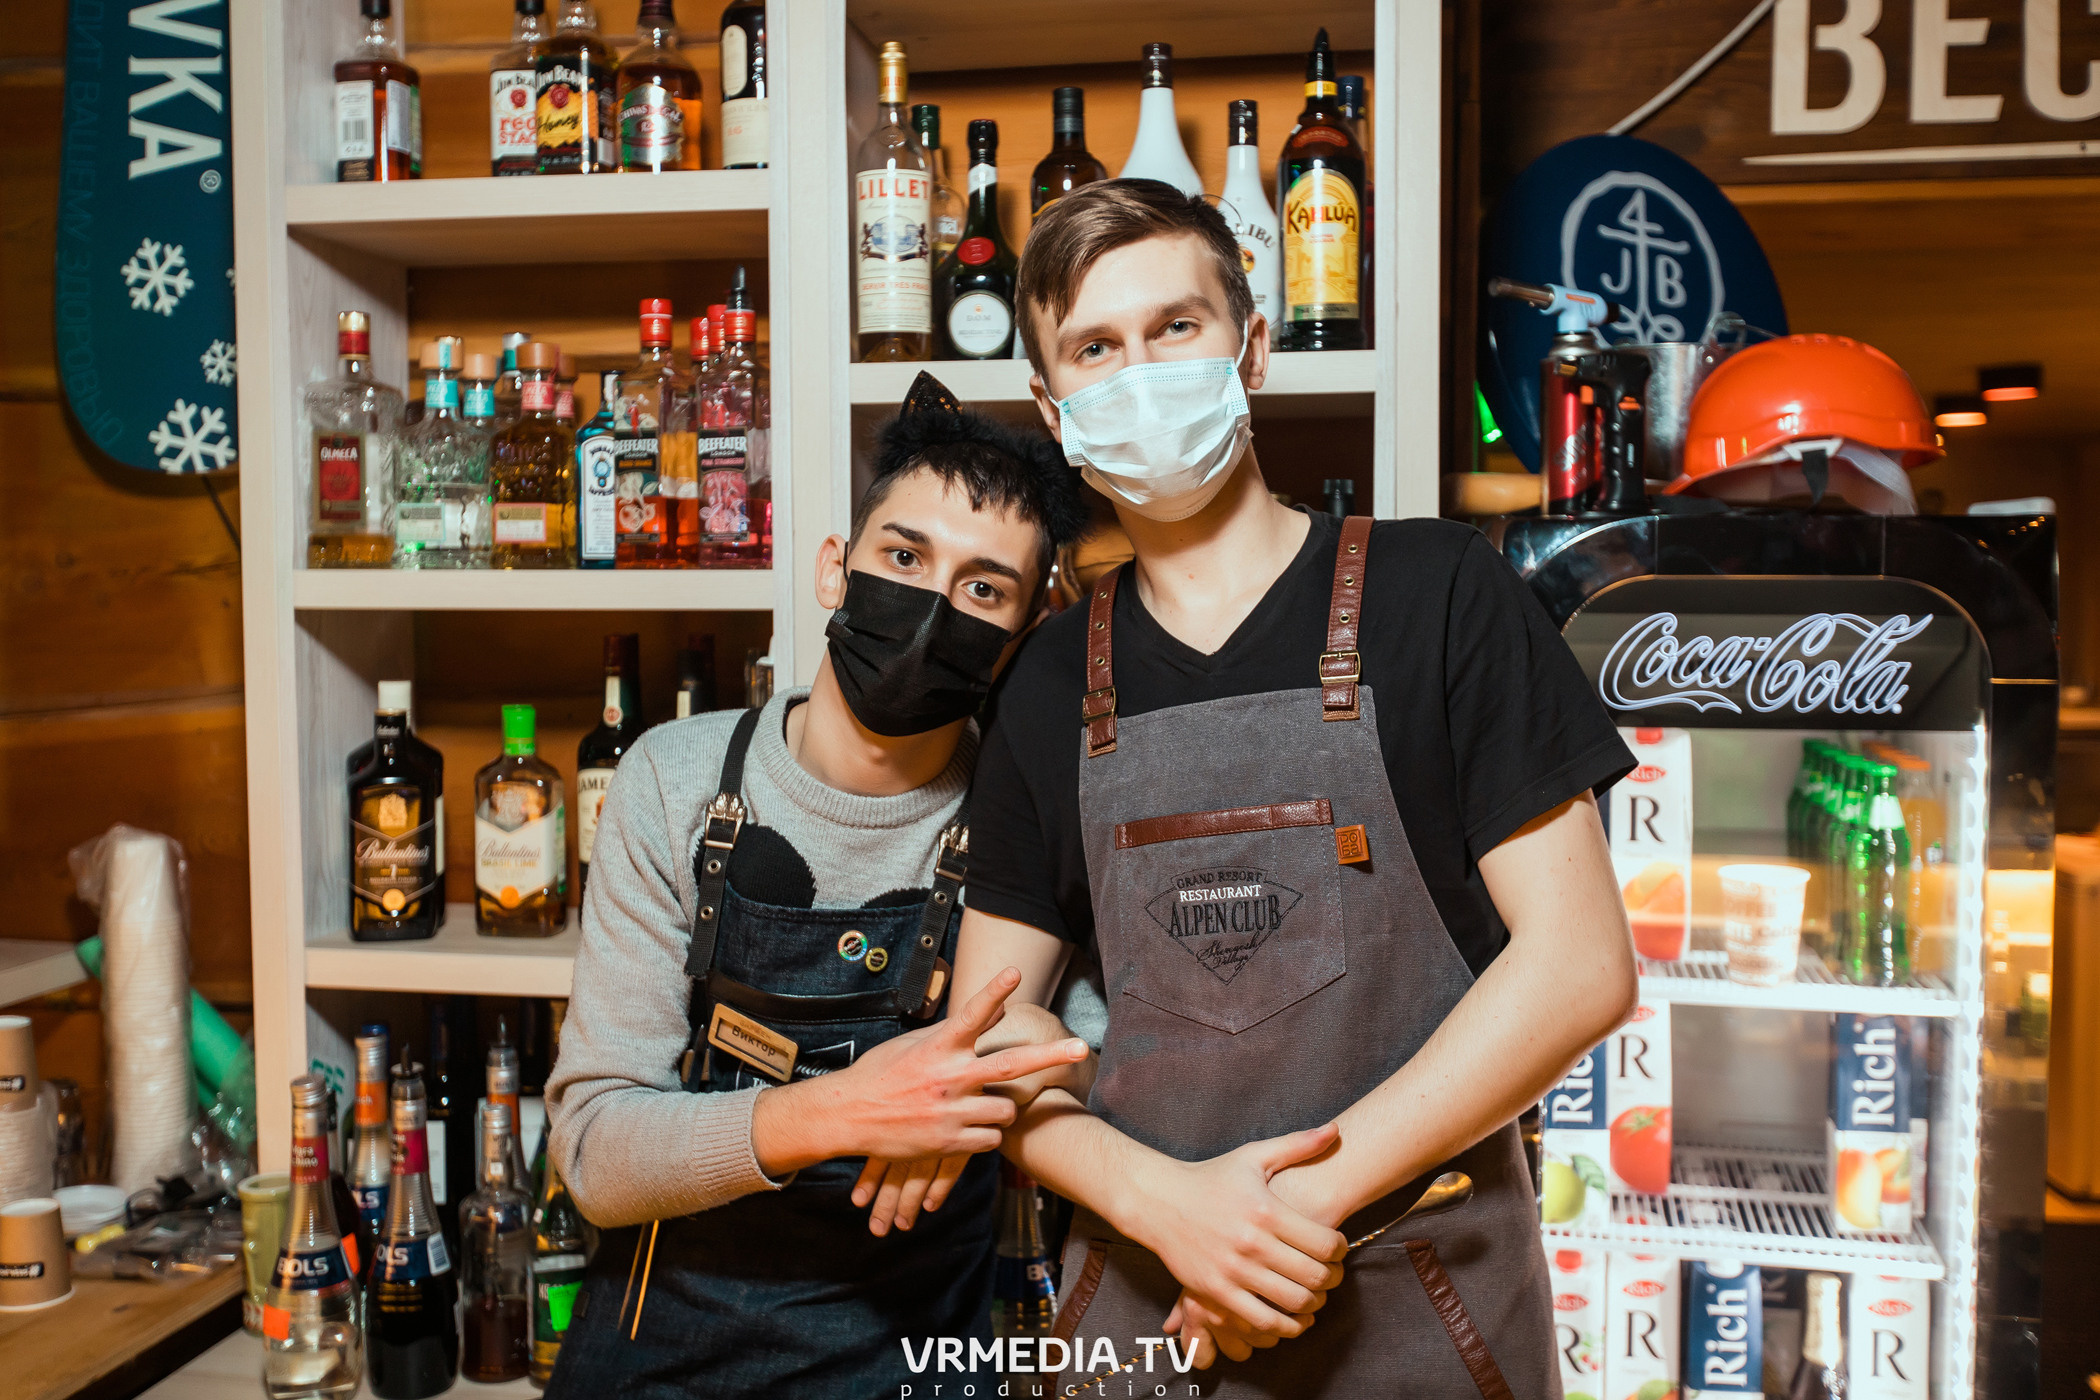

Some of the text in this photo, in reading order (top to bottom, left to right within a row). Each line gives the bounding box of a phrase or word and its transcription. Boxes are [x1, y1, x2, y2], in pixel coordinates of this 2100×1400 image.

[536, 111, 582, 136] Honey
[858, 178, 930, 201] LILLET
[615, 437, 659, 454] BEEFEATER
[698, 437, 748, 454] BEEFEATER
[1599, 612, 1934, 715] Coca-Cola
[1628, 795, 1665, 844] R
[1176, 869, 1263, 890] GRAND RESORT
[1178, 884, 1263, 903] RESTAURANT
[1169, 892, 1283, 938] ALPEN CLUB
[731, 1024, 777, 1057] Виктор
[1618, 1034, 1655, 1080] R
[1851, 1022, 1897, 1128] Rich
[276, 1255, 331, 1278] BOLS
[1625, 1309, 1665, 1360] R
[1705, 1280, 1747, 1391] Rich
[1871, 1328, 1911, 1382] R
